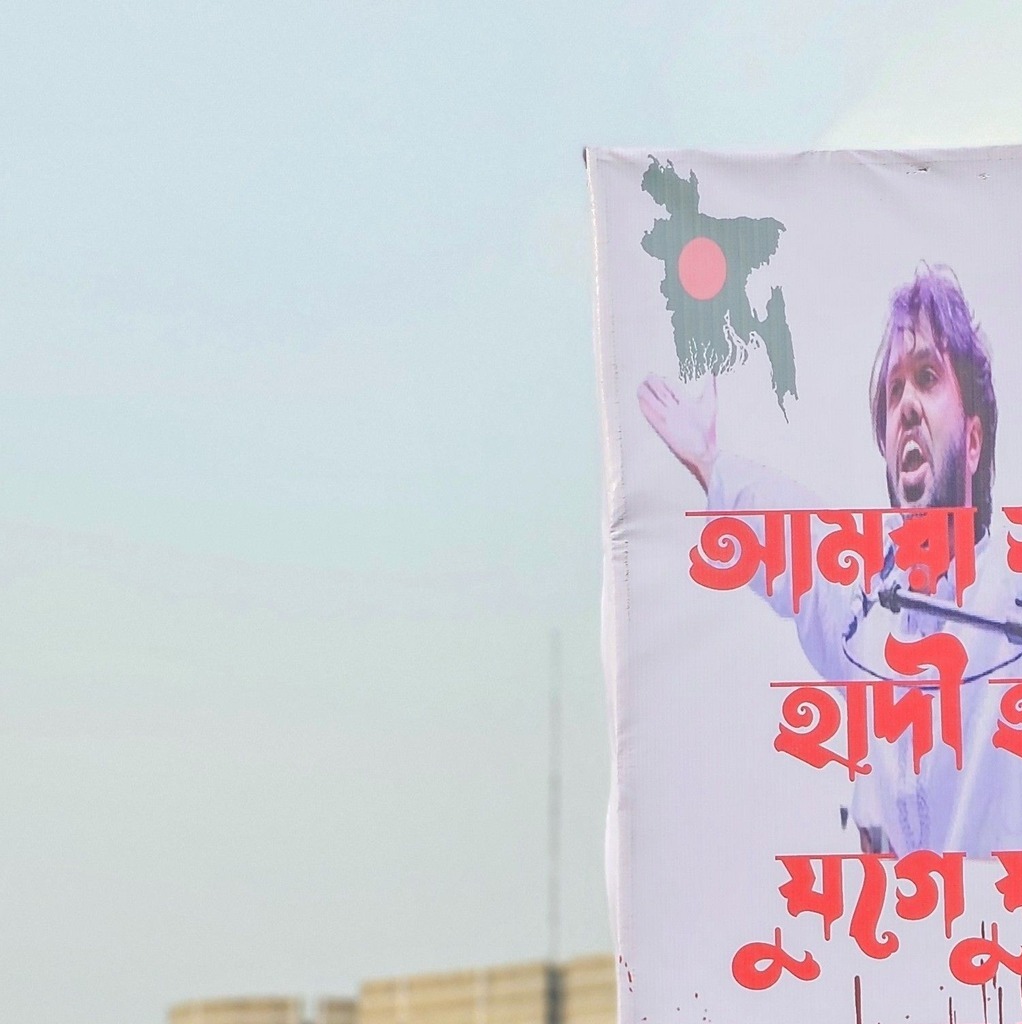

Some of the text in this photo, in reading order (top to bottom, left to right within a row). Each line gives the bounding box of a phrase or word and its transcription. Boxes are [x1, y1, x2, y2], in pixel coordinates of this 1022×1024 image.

[685, 506, 977, 613] আমরা
[769, 632, 969, 781] হাদী
[731, 849, 967, 991] যুগে
